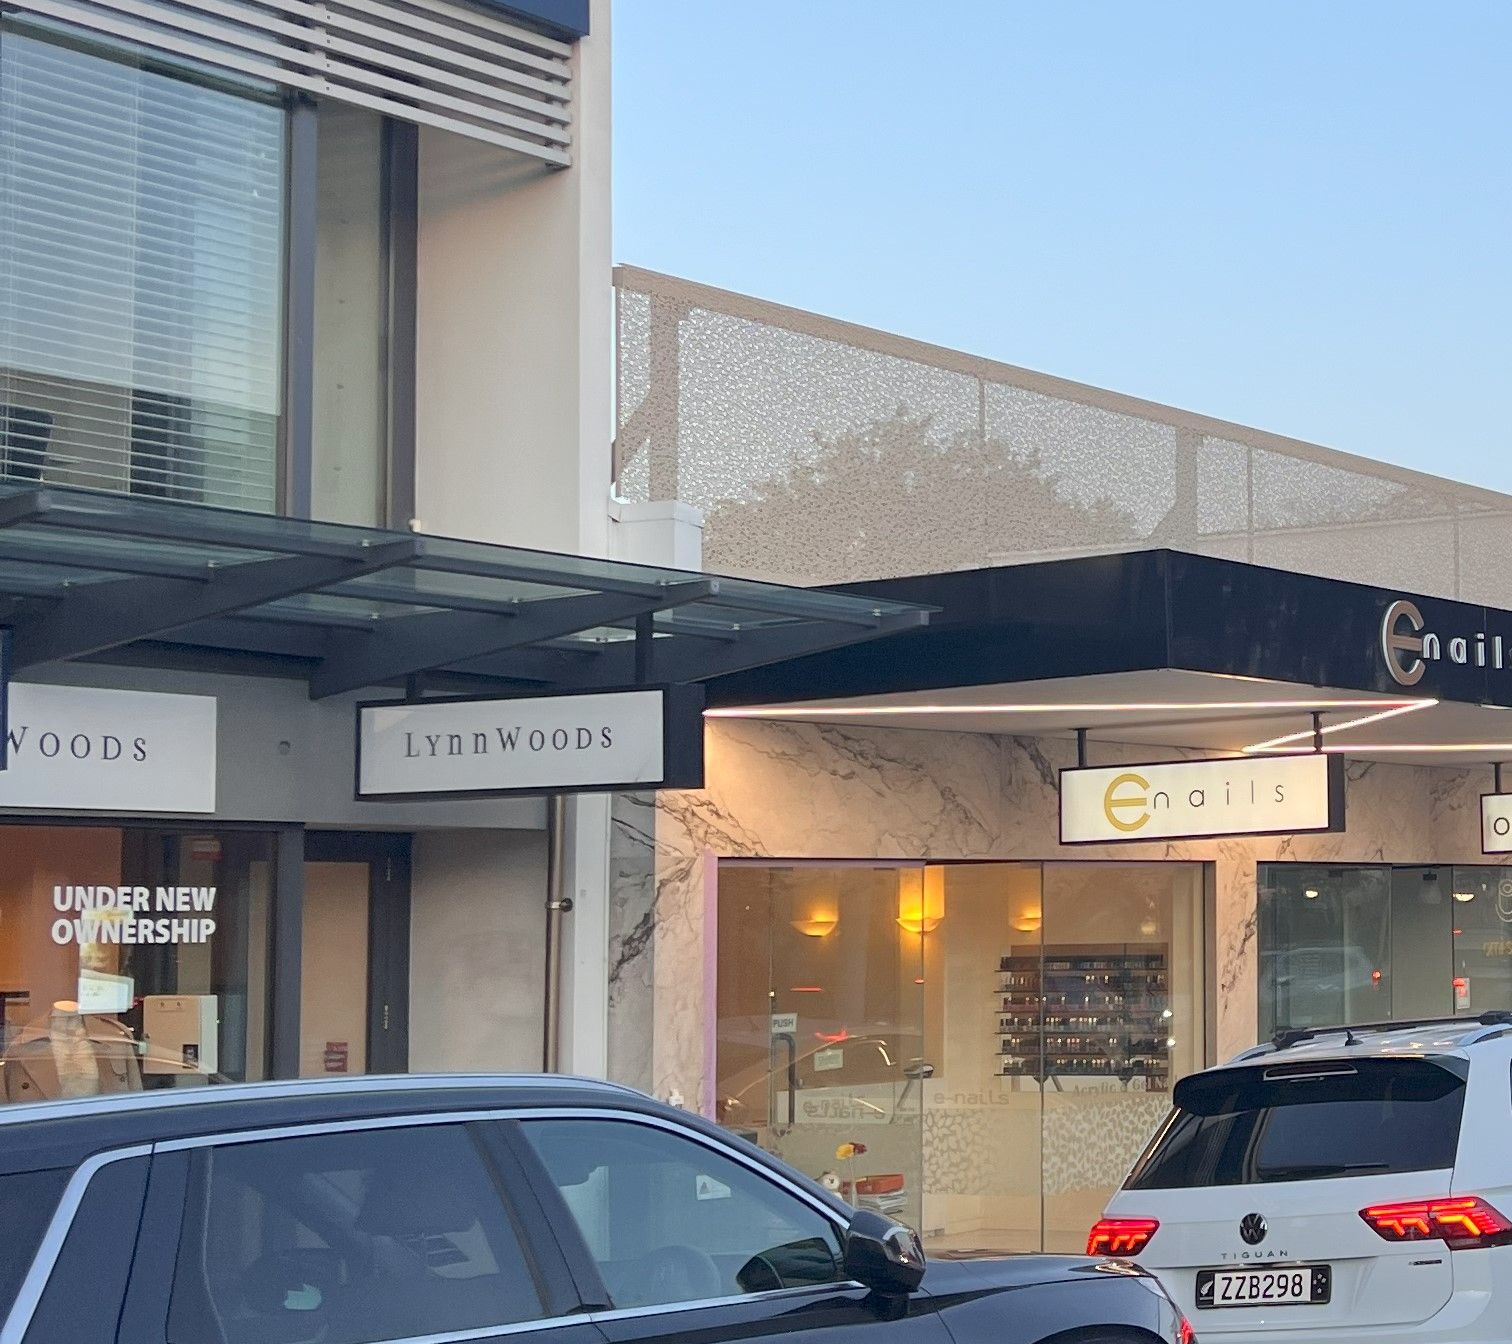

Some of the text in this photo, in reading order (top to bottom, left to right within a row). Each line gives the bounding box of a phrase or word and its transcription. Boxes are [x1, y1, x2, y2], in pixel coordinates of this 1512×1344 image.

[53, 886, 216, 912] UNDER NEW
[51, 918, 216, 945] OWNERSHIP
[772, 1017, 794, 1029] PUSH
[934, 1088, 1010, 1106] e-nails
[1221, 1250, 1288, 1259] TIGUAN
[1221, 1274, 1303, 1300] ZZB298
